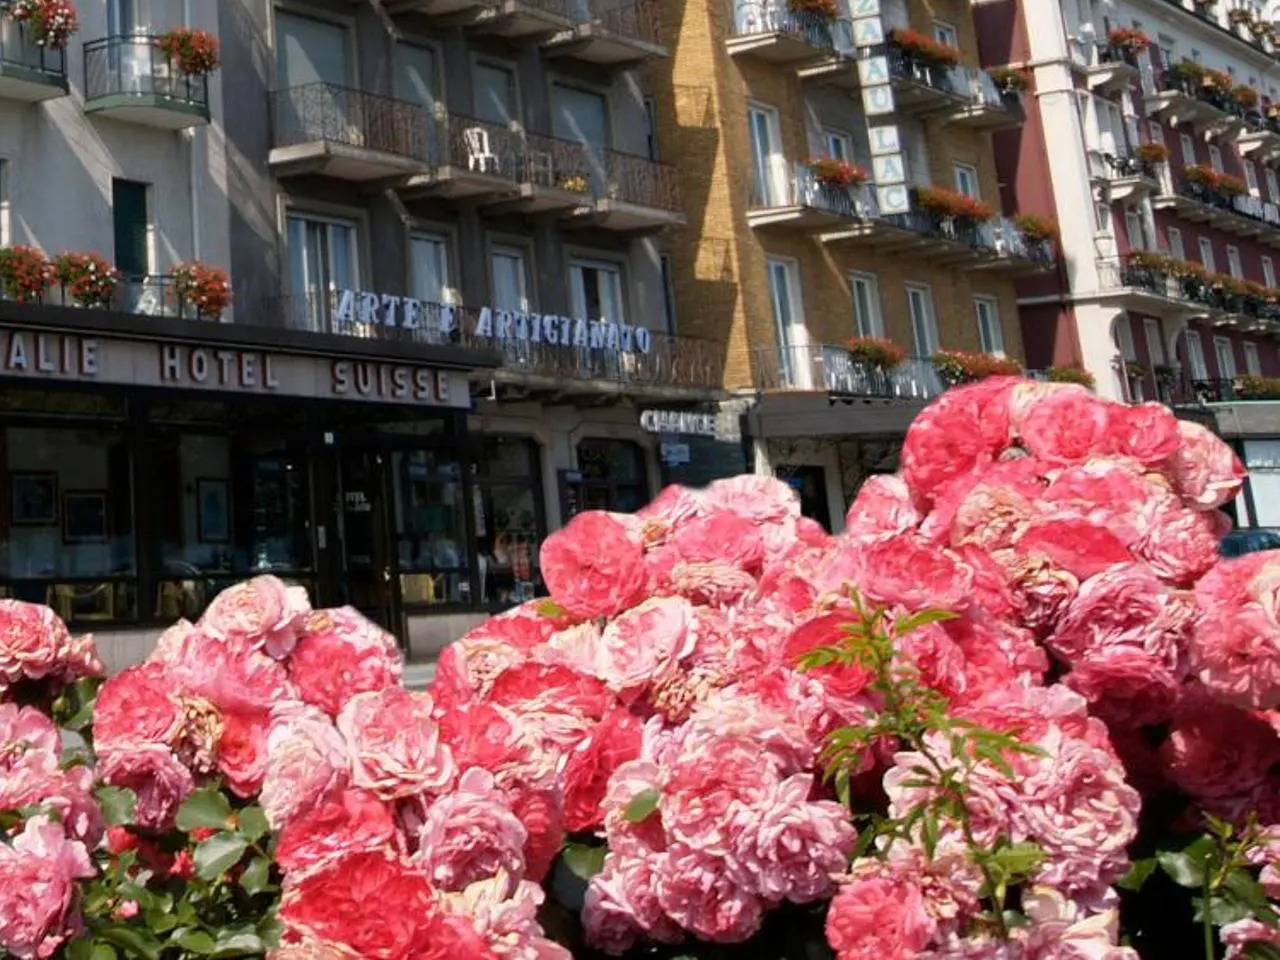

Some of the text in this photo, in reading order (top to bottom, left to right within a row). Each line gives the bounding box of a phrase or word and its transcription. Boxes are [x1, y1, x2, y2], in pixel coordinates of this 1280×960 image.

[865, 59, 889, 109] AU
[874, 129, 906, 209] LAC
[336, 290, 652, 355] ARTE E ARTIGIANATO
[160, 344, 280, 389] HOTEL
[332, 359, 451, 402] SUISSE
